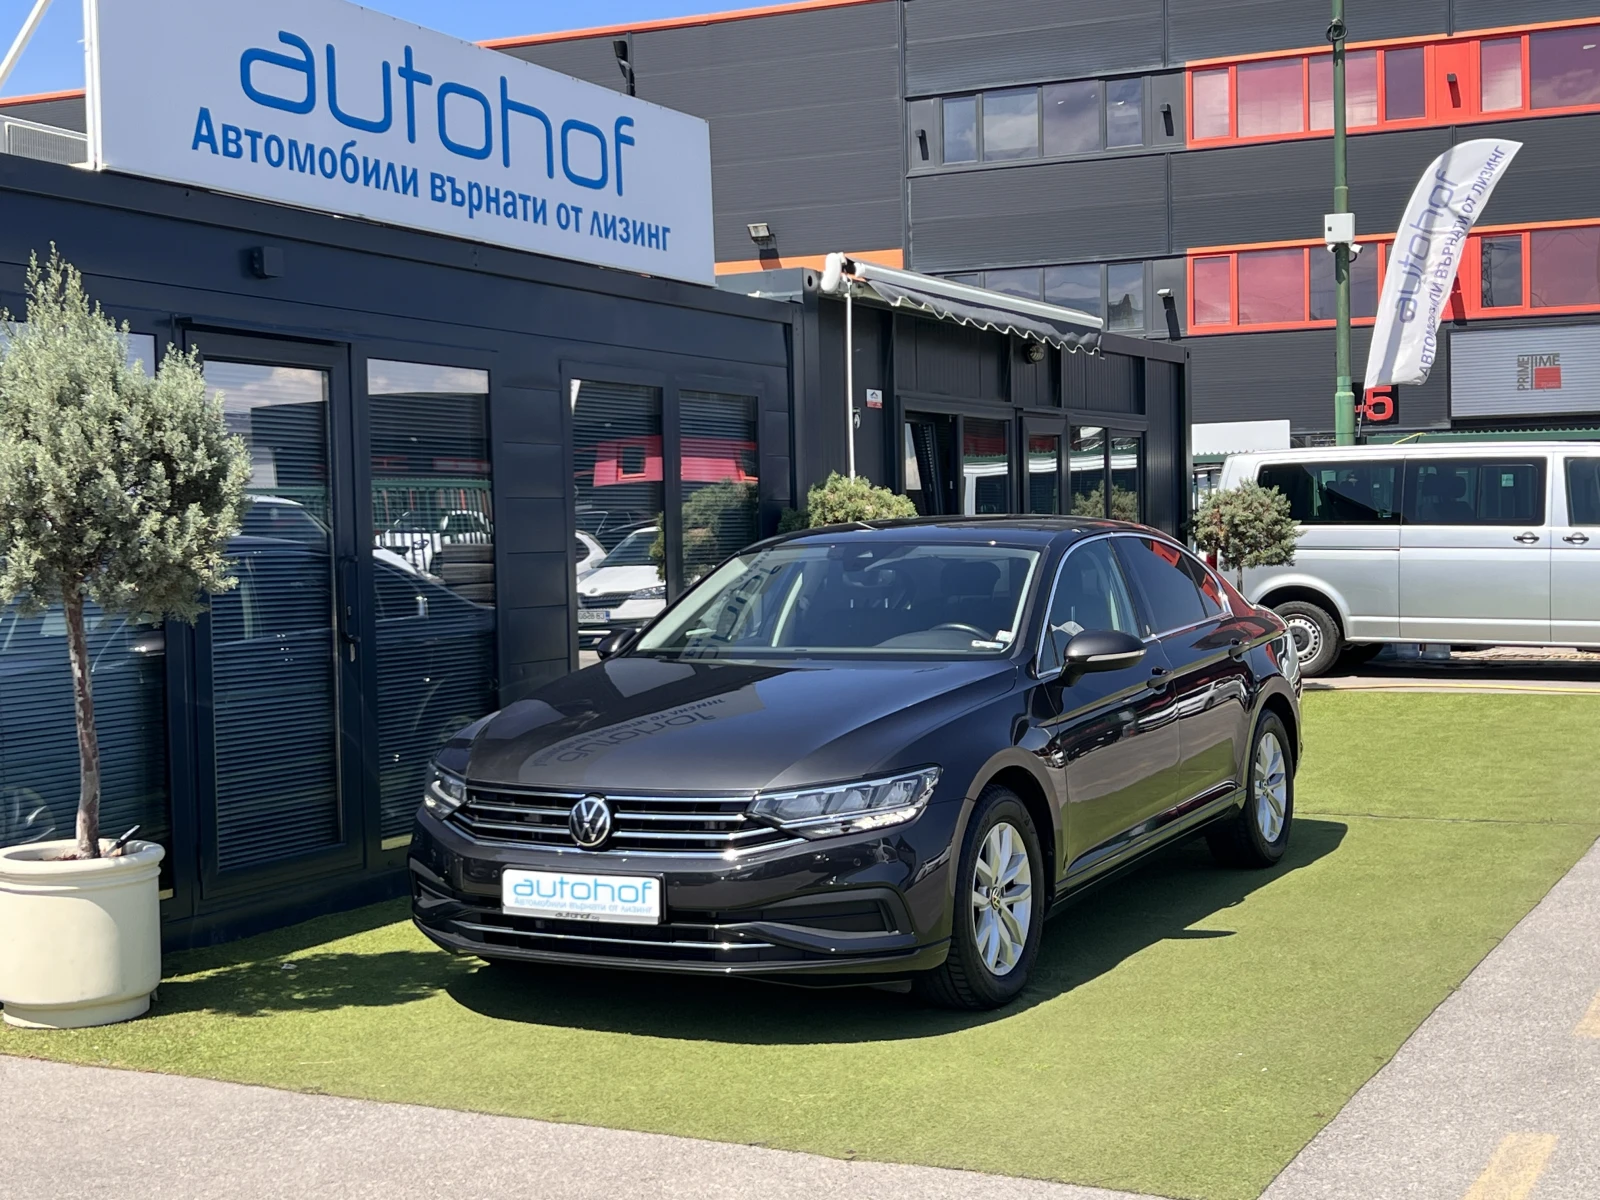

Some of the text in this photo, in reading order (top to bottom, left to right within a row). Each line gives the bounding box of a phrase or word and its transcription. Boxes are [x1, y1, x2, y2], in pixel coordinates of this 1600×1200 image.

[240, 30, 635, 196] autohof
[191, 106, 671, 251] Автомобили върнати от лизинг
[1434, 213, 1471, 280] ВЪРНАТИ
[1462, 195, 1477, 217] ОТ
[1471, 145, 1505, 195] ЛИЗИНГ
[1395, 168, 1458, 323] autohof
[1365, 385, 1393, 421] 5
[1517, 355, 1530, 391] PRIME
[513, 876, 652, 904] autohof
[514, 897, 567, 909] Автомобили
[608, 904, 618, 912] от
